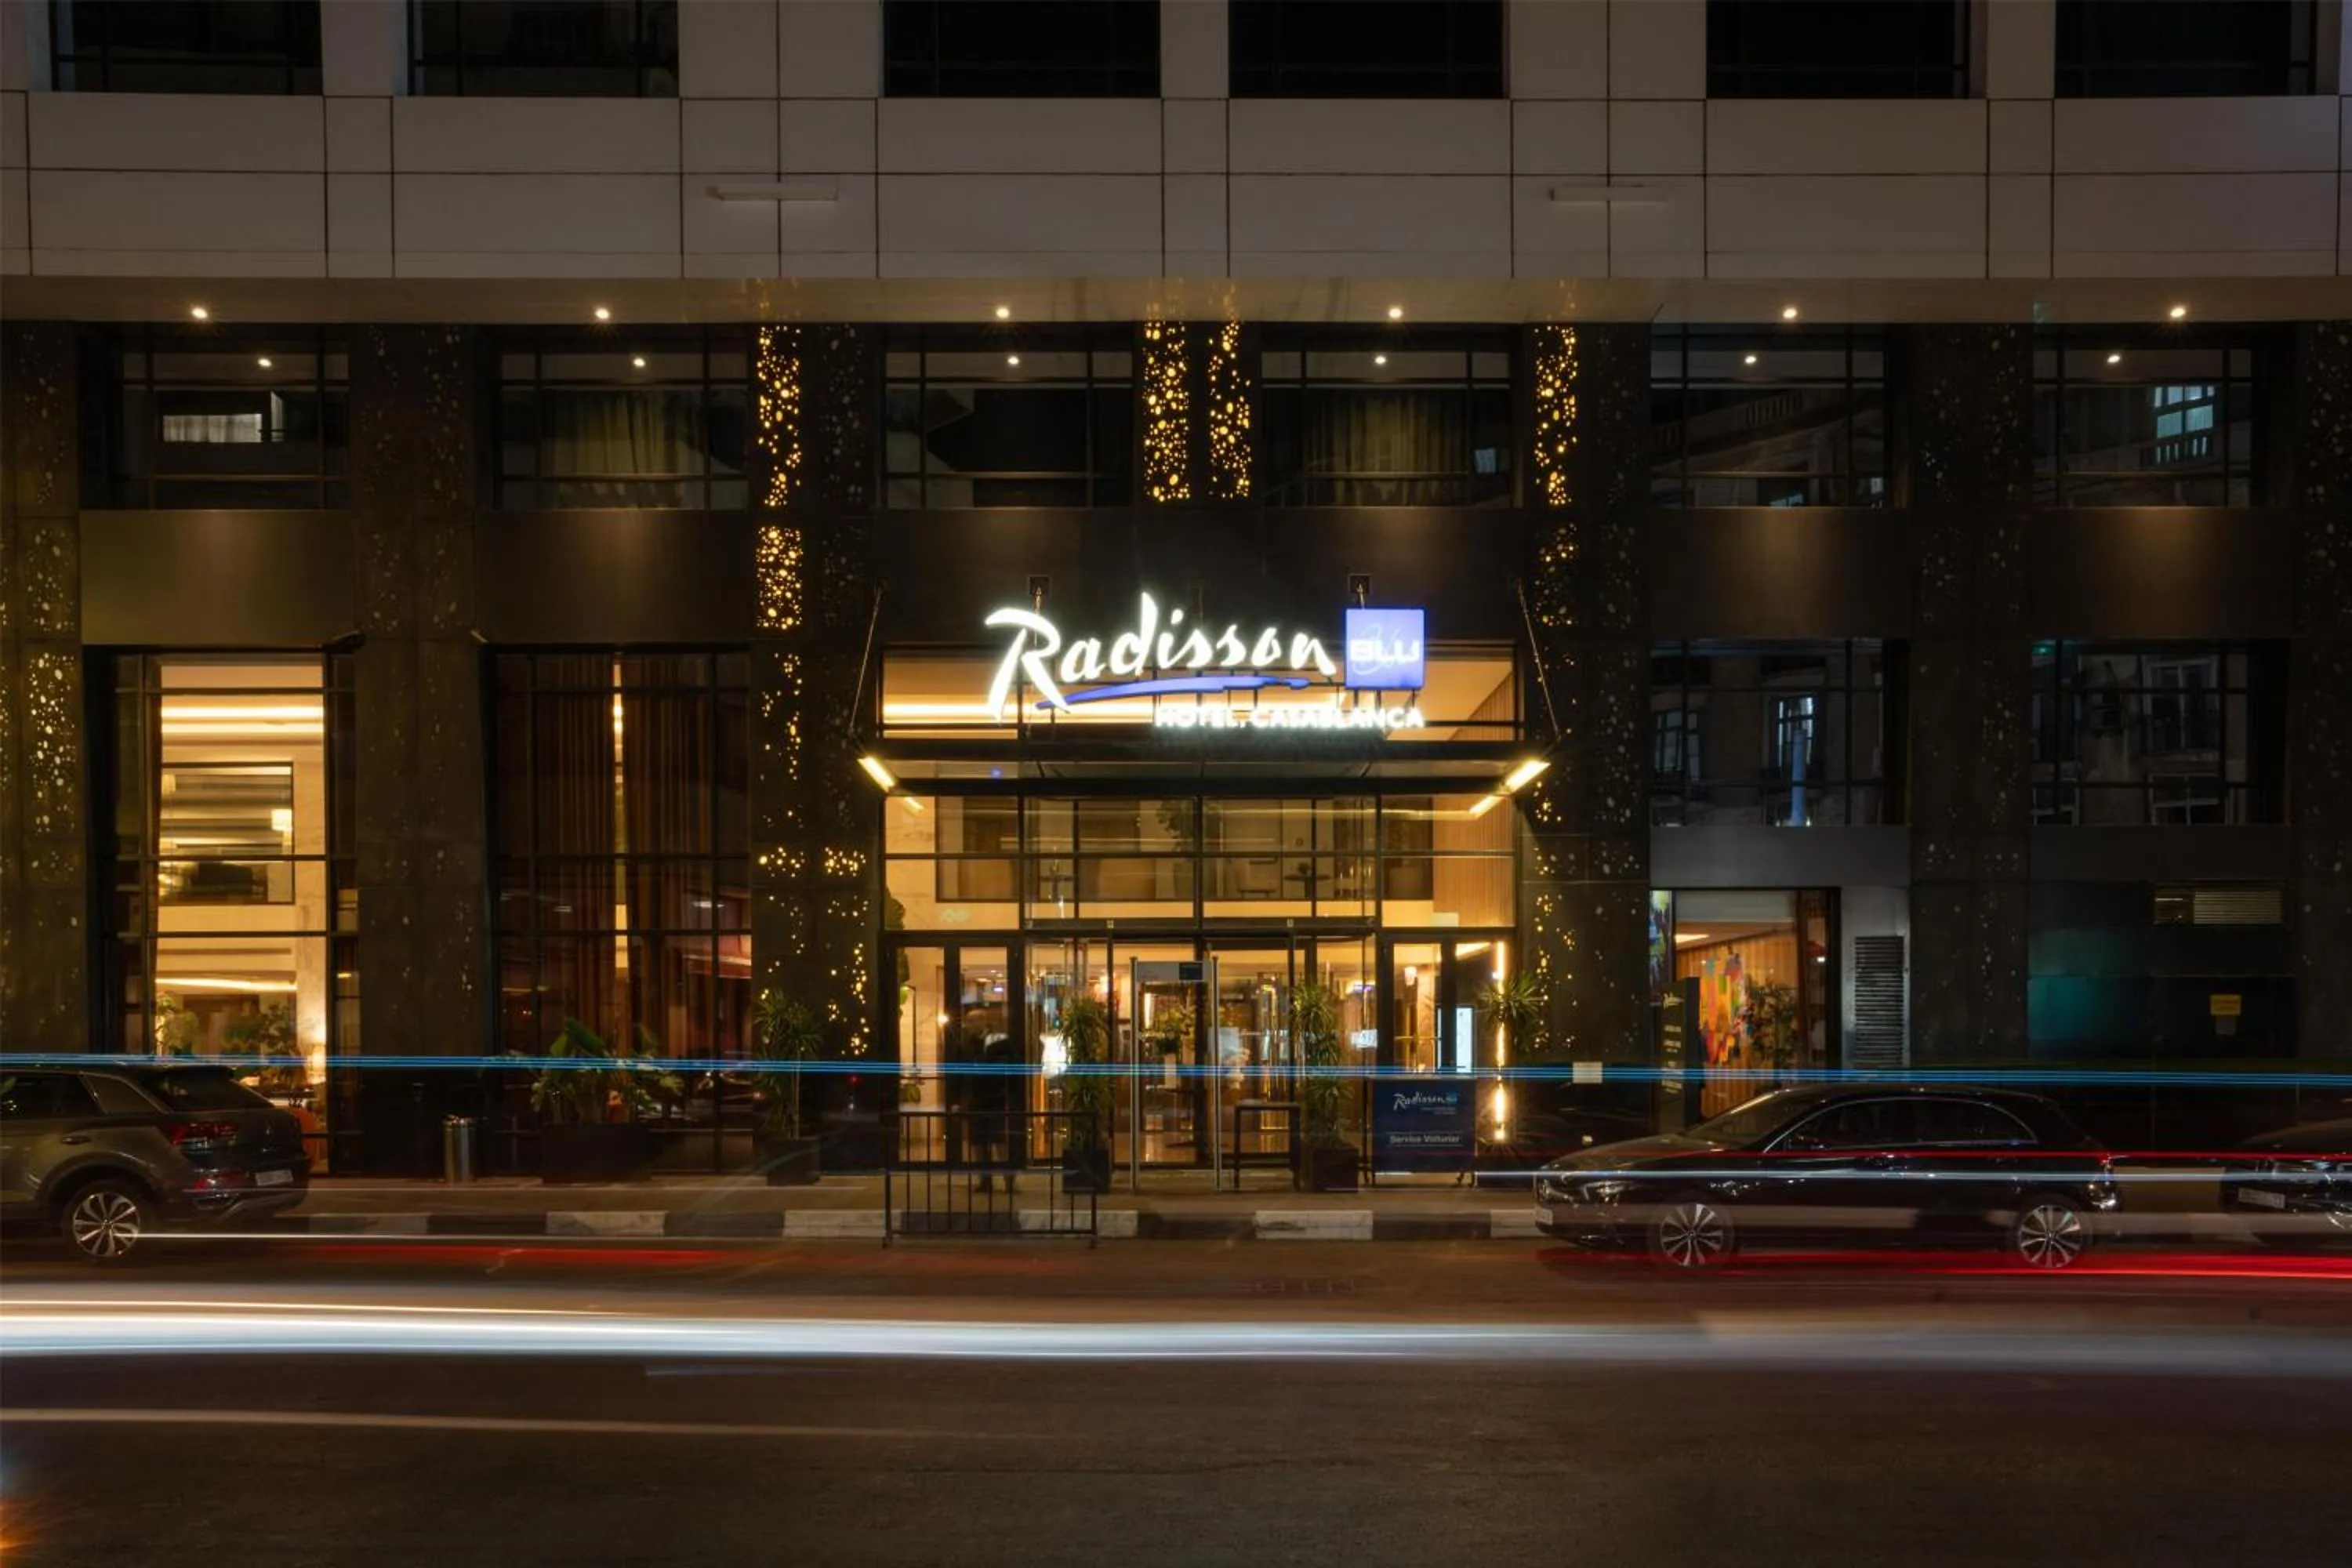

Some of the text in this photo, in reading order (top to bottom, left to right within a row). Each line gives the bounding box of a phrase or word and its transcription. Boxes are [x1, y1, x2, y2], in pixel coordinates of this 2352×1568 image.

[985, 591, 1336, 724] Radisson
[1250, 706, 1425, 728] CASABLANCA
[1392, 1091, 1446, 1111] Radisson
